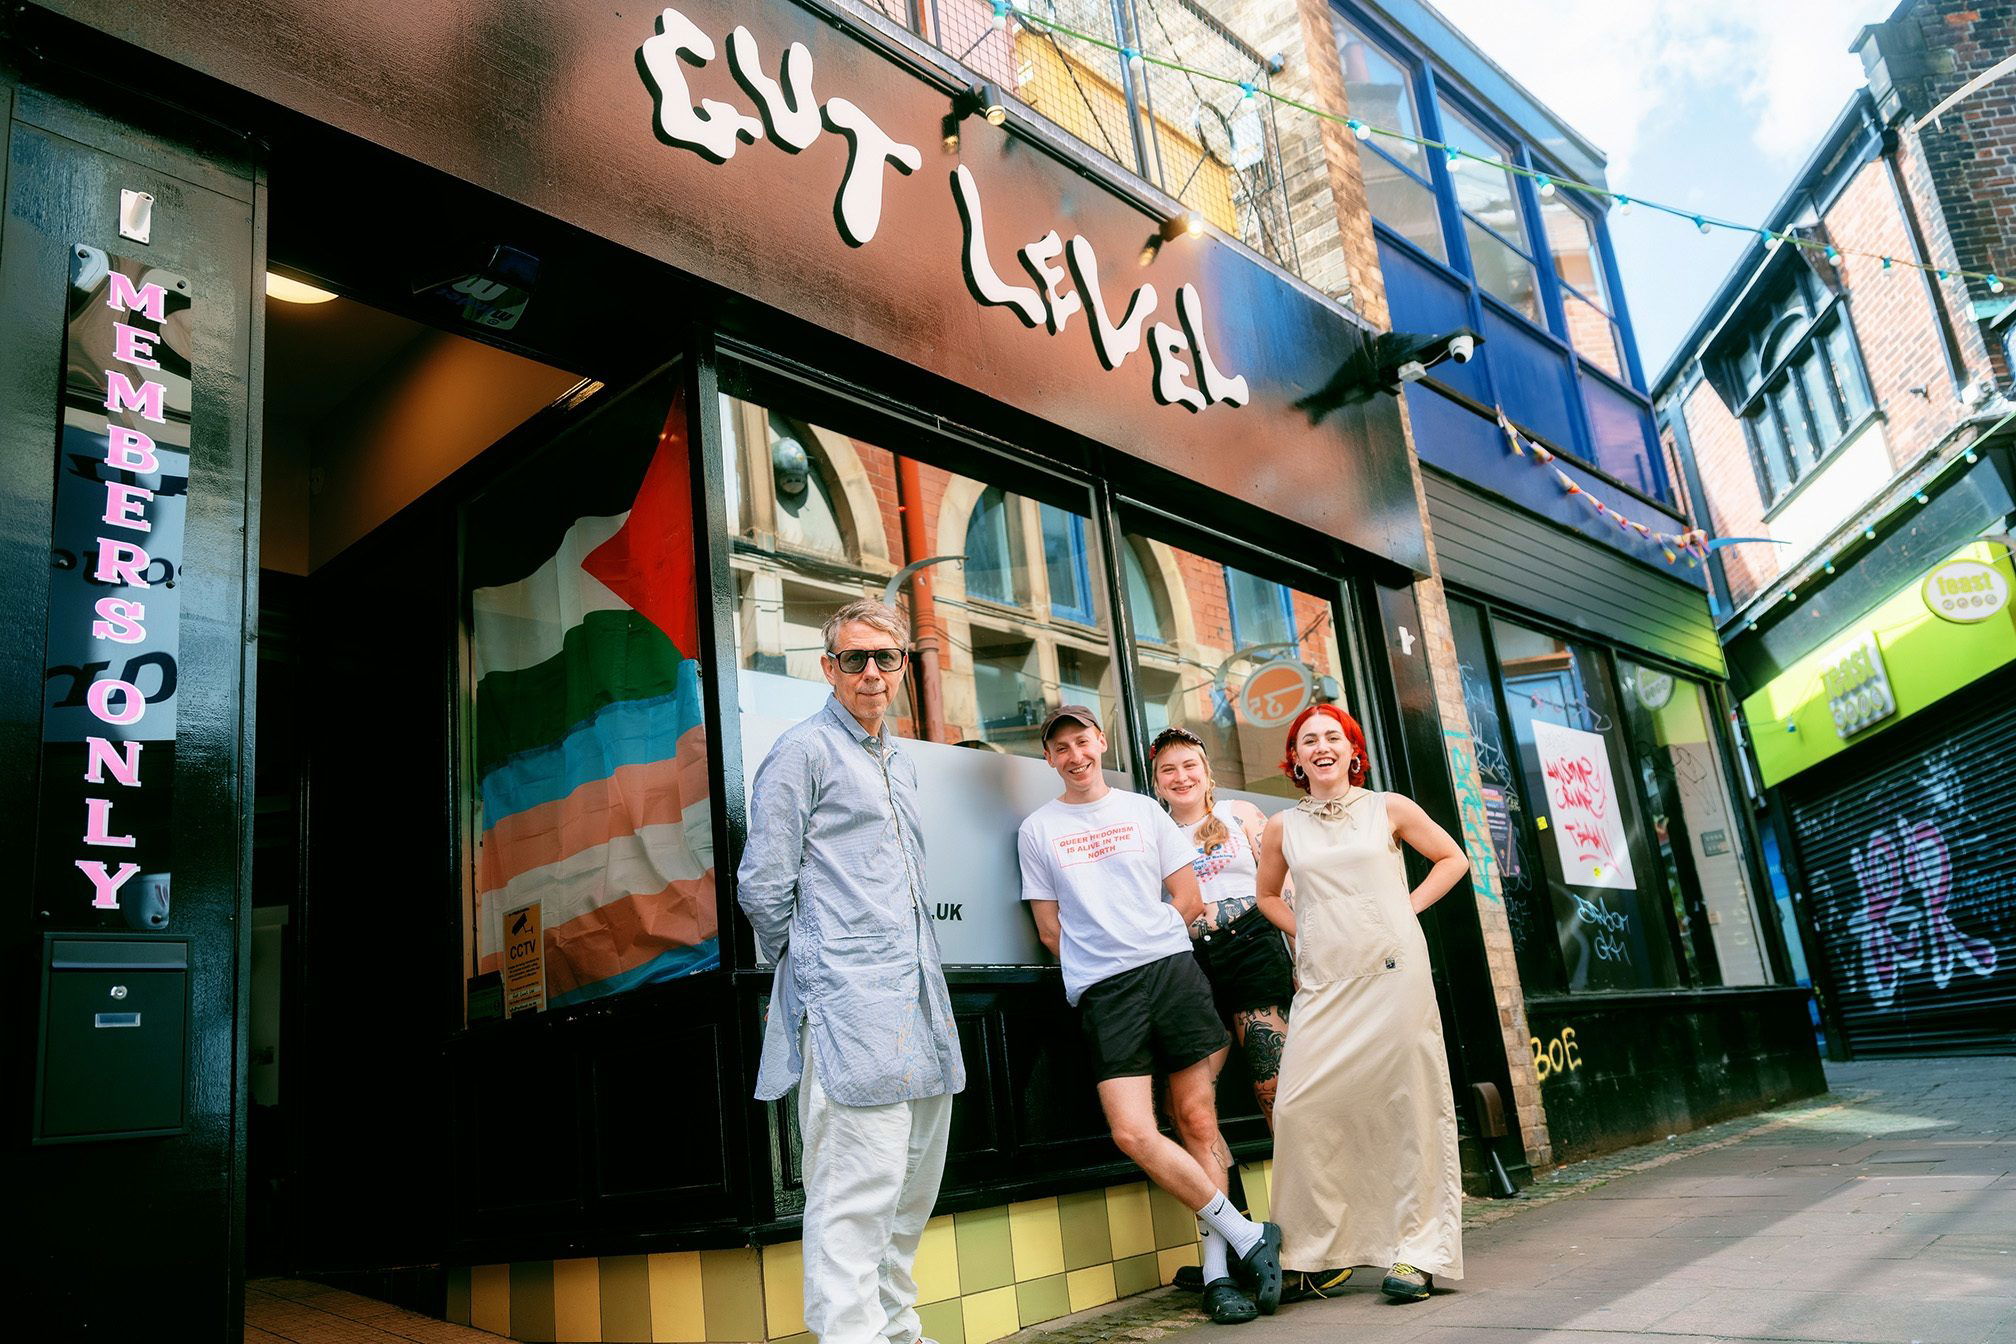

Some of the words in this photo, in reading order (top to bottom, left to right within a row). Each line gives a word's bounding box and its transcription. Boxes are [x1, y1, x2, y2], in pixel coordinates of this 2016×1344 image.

[636, 8, 922, 247] GUT
[951, 164, 1249, 412] LEVEL
[92, 270, 168, 645] MEMBERS
[75, 678, 144, 911] ONLY
[1060, 837, 1088, 847] QUEER
[1090, 827, 1133, 839] HEDONISM
[1077, 841, 1101, 852] ALIVE
[1114, 833, 1131, 843] THE
[1088, 845, 1116, 859] NORTH
[510, 939, 536, 960] CCTV
